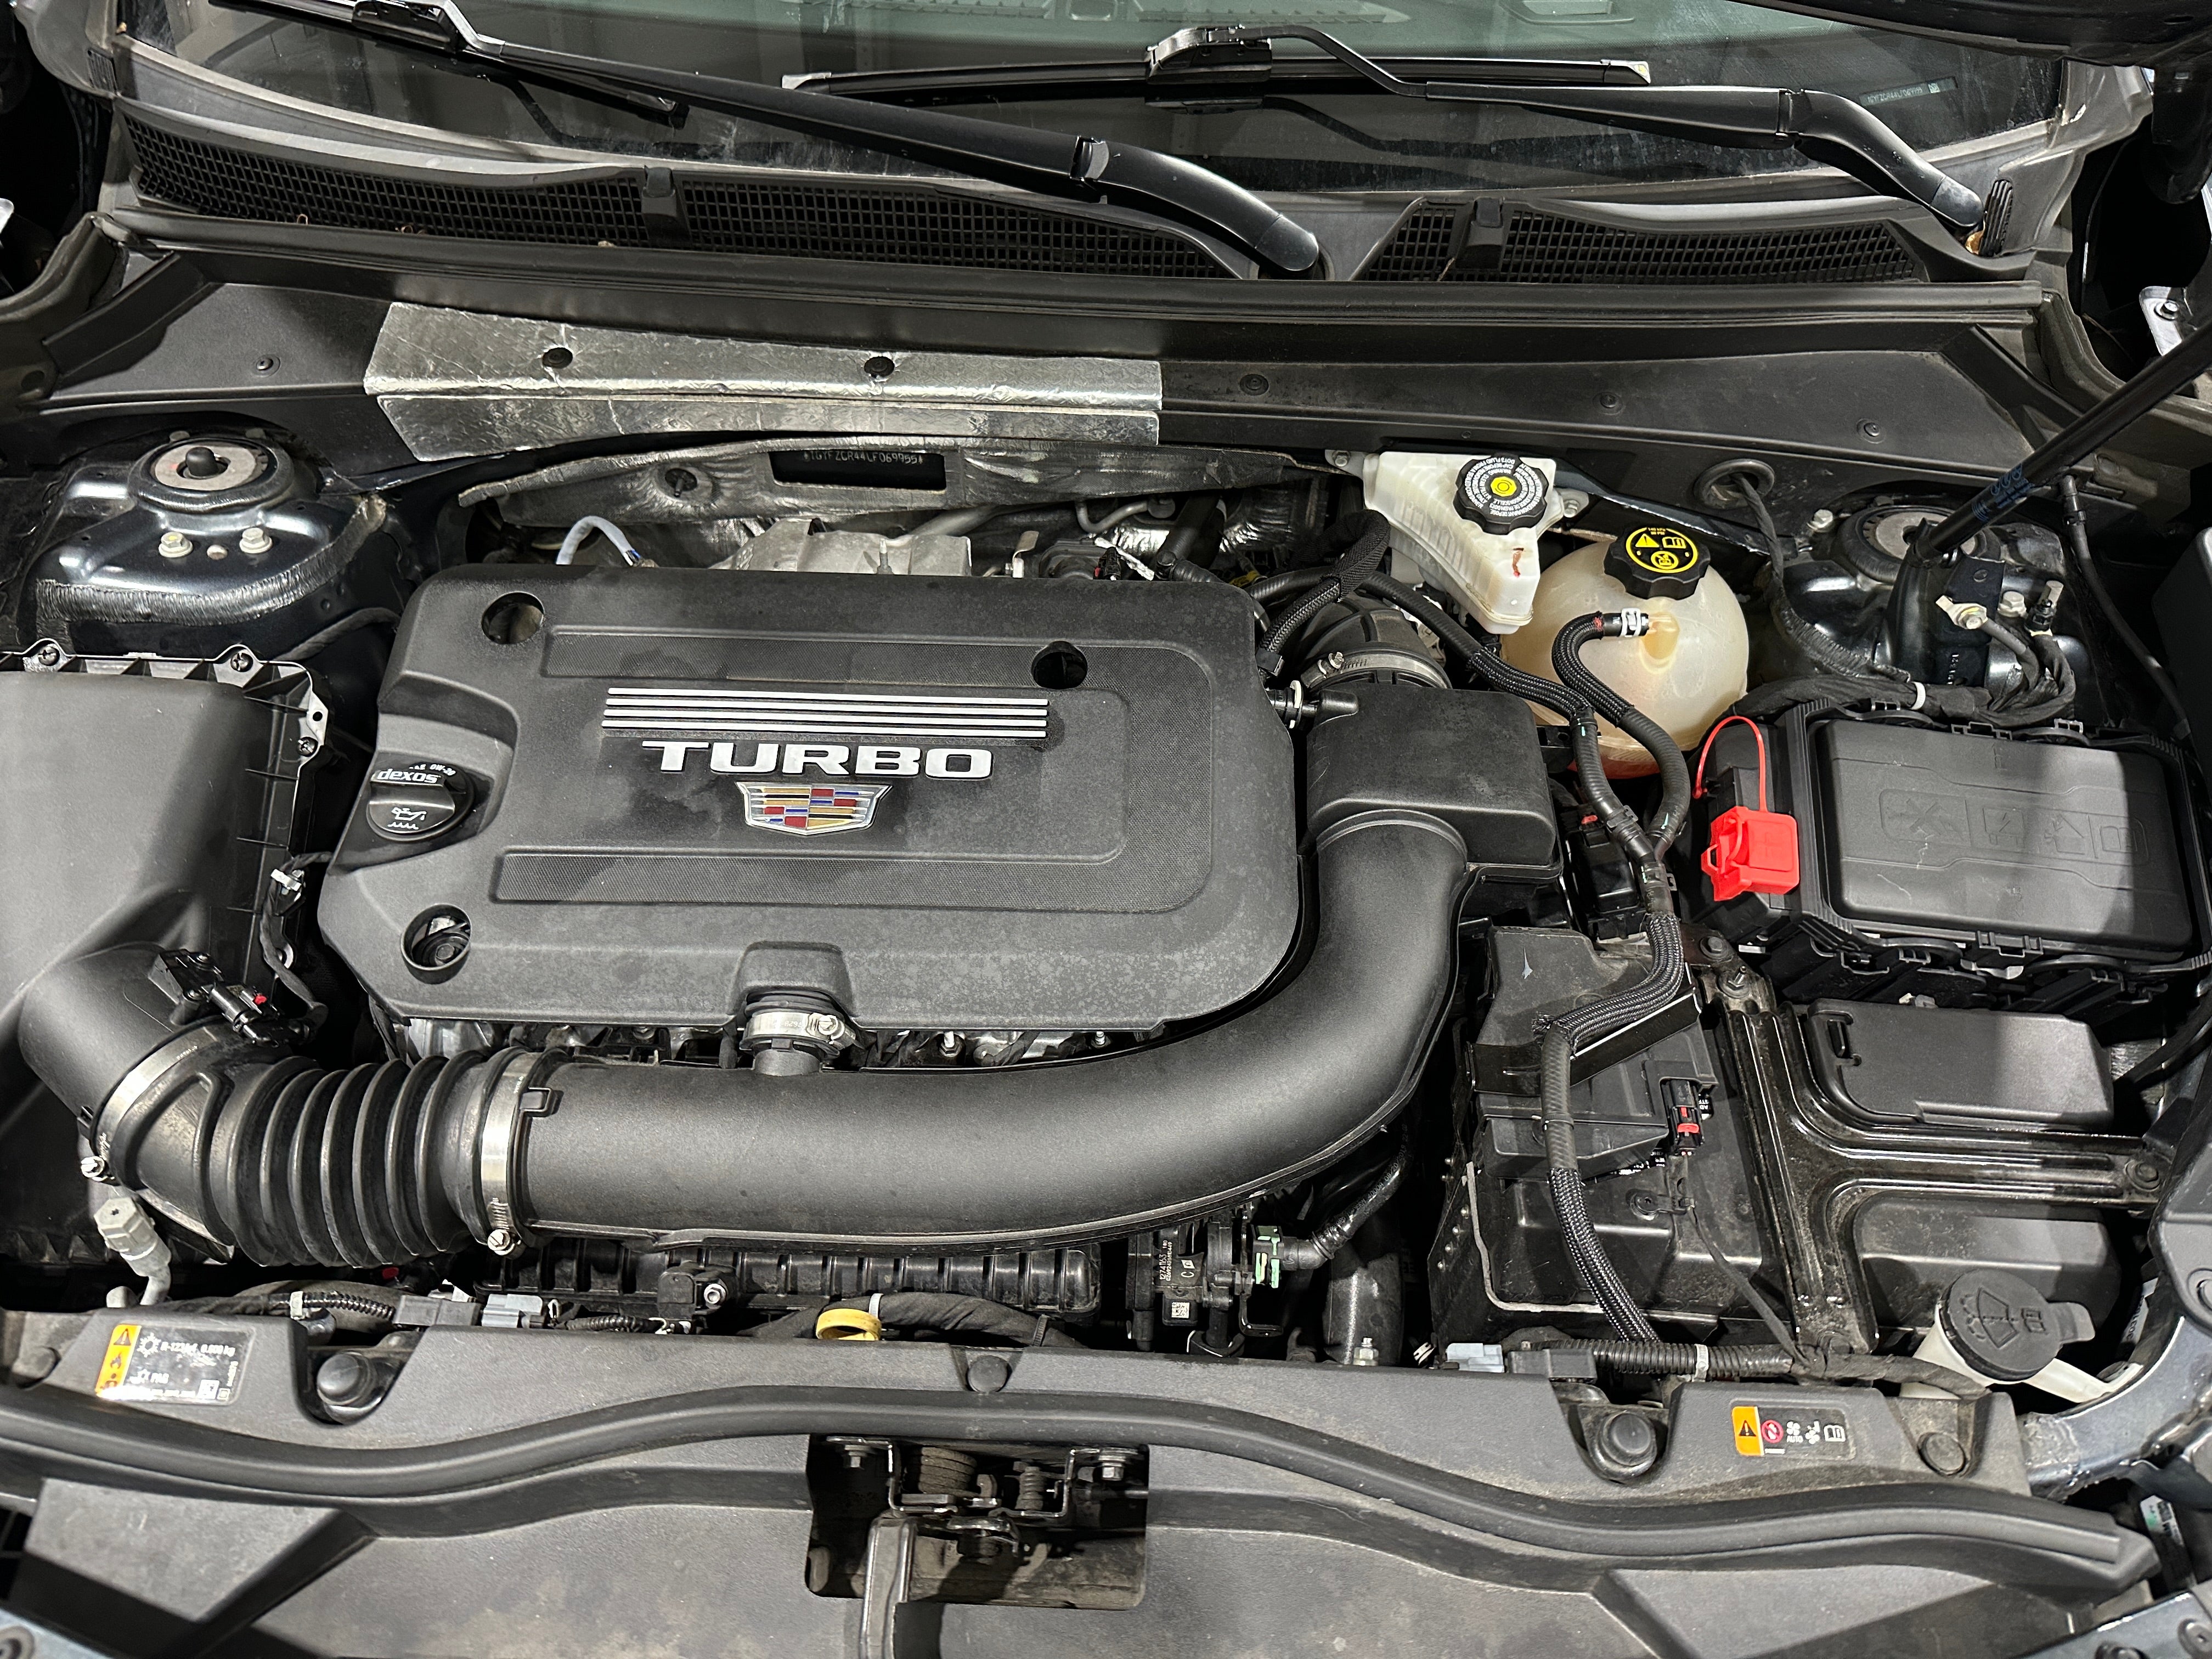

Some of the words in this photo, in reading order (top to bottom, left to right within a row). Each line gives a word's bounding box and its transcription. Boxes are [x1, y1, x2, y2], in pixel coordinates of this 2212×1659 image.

[641, 740, 995, 780] TURBO
[377, 768, 439, 783] dexos
[430, 764, 456, 776] 0W-20
[1383, 1144, 1407, 1182] 08/20/2019
[1787, 1435, 1804, 1443] AUTO
